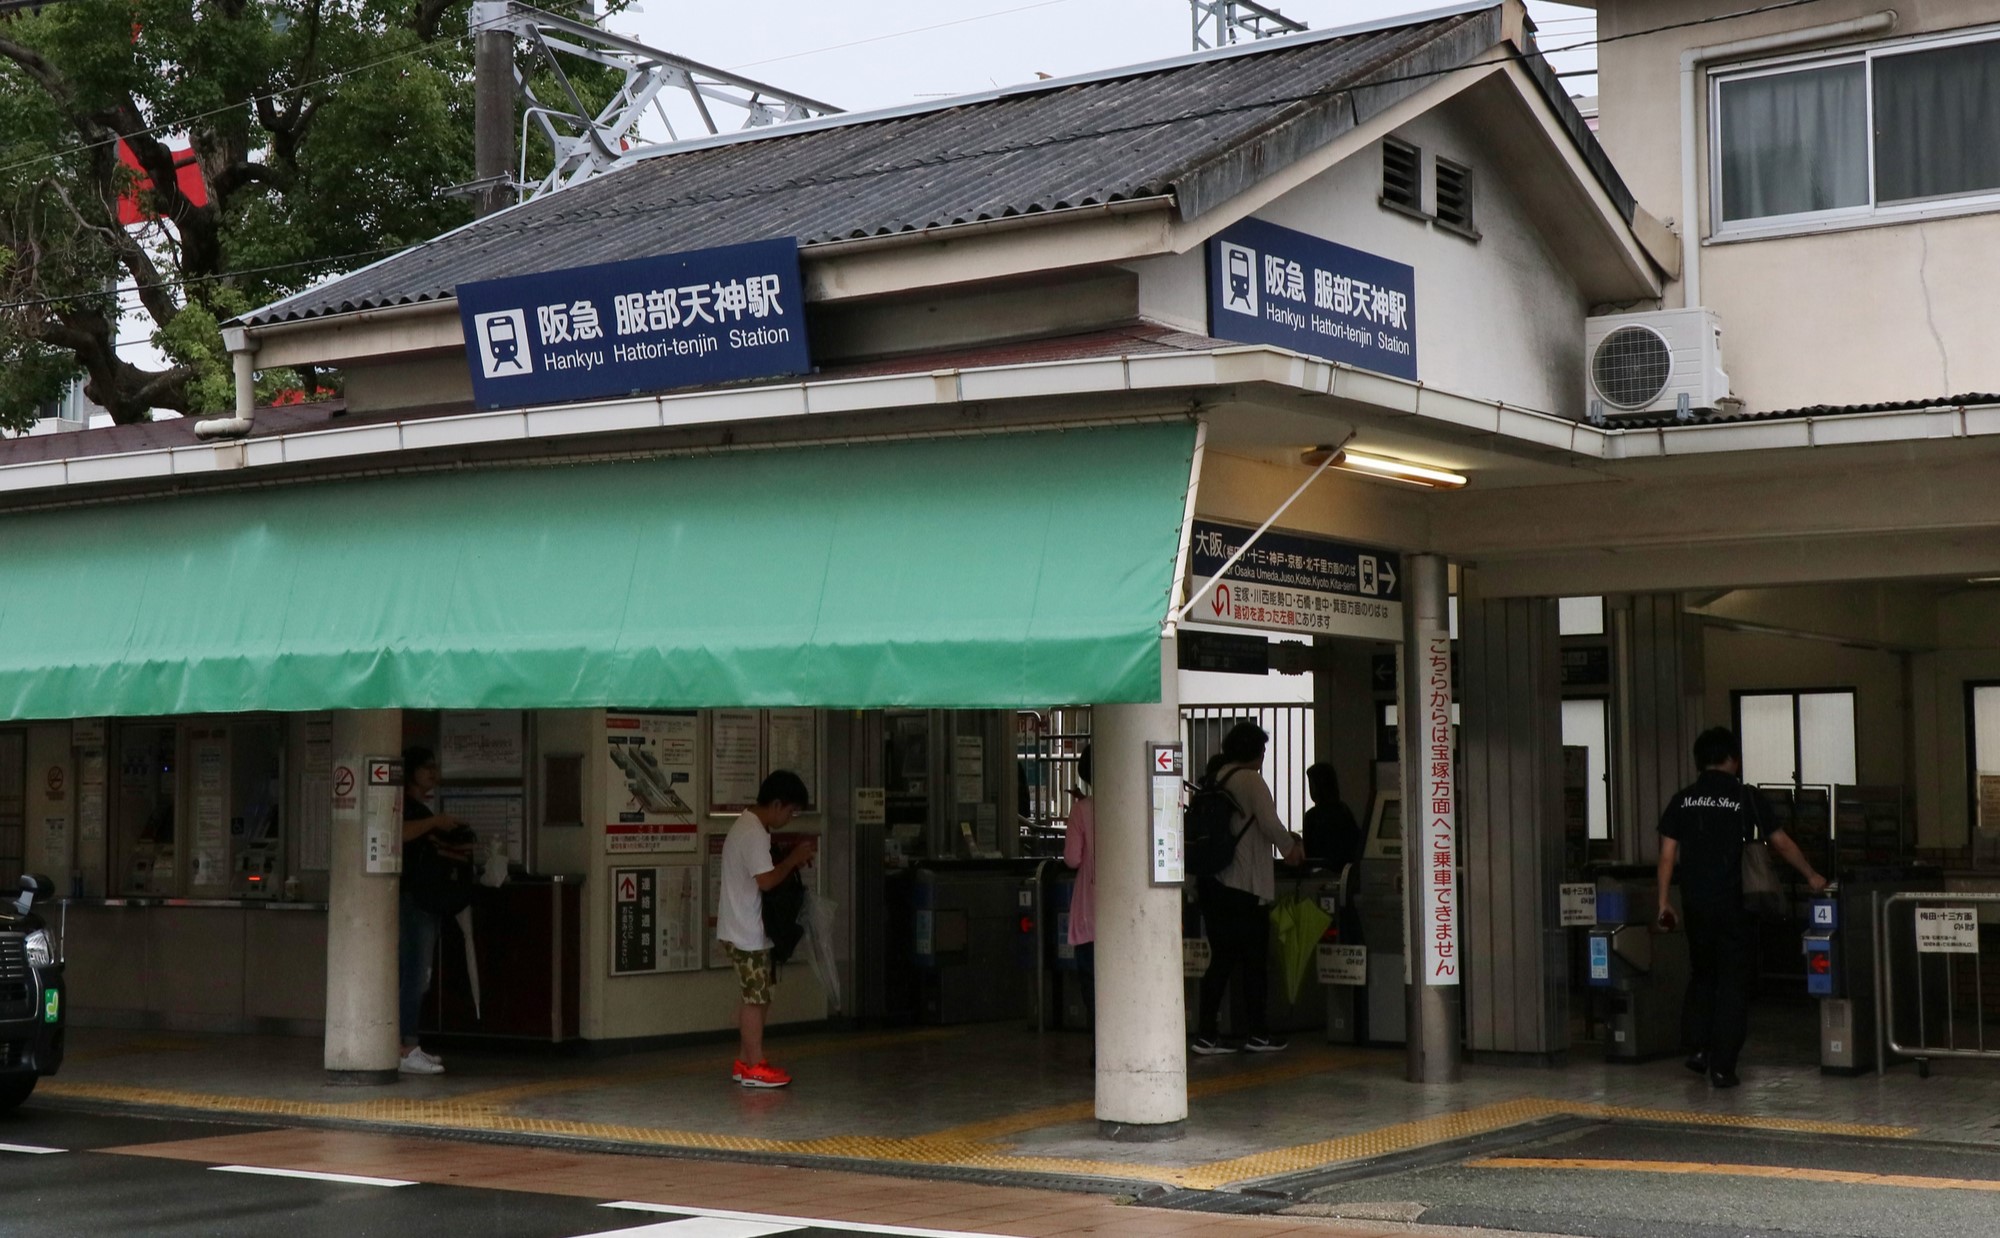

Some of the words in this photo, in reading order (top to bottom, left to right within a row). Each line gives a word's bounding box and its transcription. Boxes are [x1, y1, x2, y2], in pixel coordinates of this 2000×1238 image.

[537, 300, 603, 345] 阪急
[614, 274, 784, 336] 服部天神駅
[1264, 254, 1307, 303] 阪急
[1314, 268, 1408, 331] 服部天神駅
[544, 350, 604, 371] Hankyu
[613, 334, 718, 363] Hattori-tenjin
[729, 327, 790, 349] Station
[1266, 302, 1305, 331] Hankyu
[1311, 313, 1372, 349] Hattori-tenjin
[1378, 330, 1410, 356] Station
[1234, 564, 1255, 578] Osaka
[1234, 604, 1331, 630] 踏切を渡った左側にあります
[1429, 638, 1455, 977] こちらからは宝塚方面へご乗車できません
[1681, 796, 1716, 808] Mobile
[1818, 908, 1827, 921] 4
